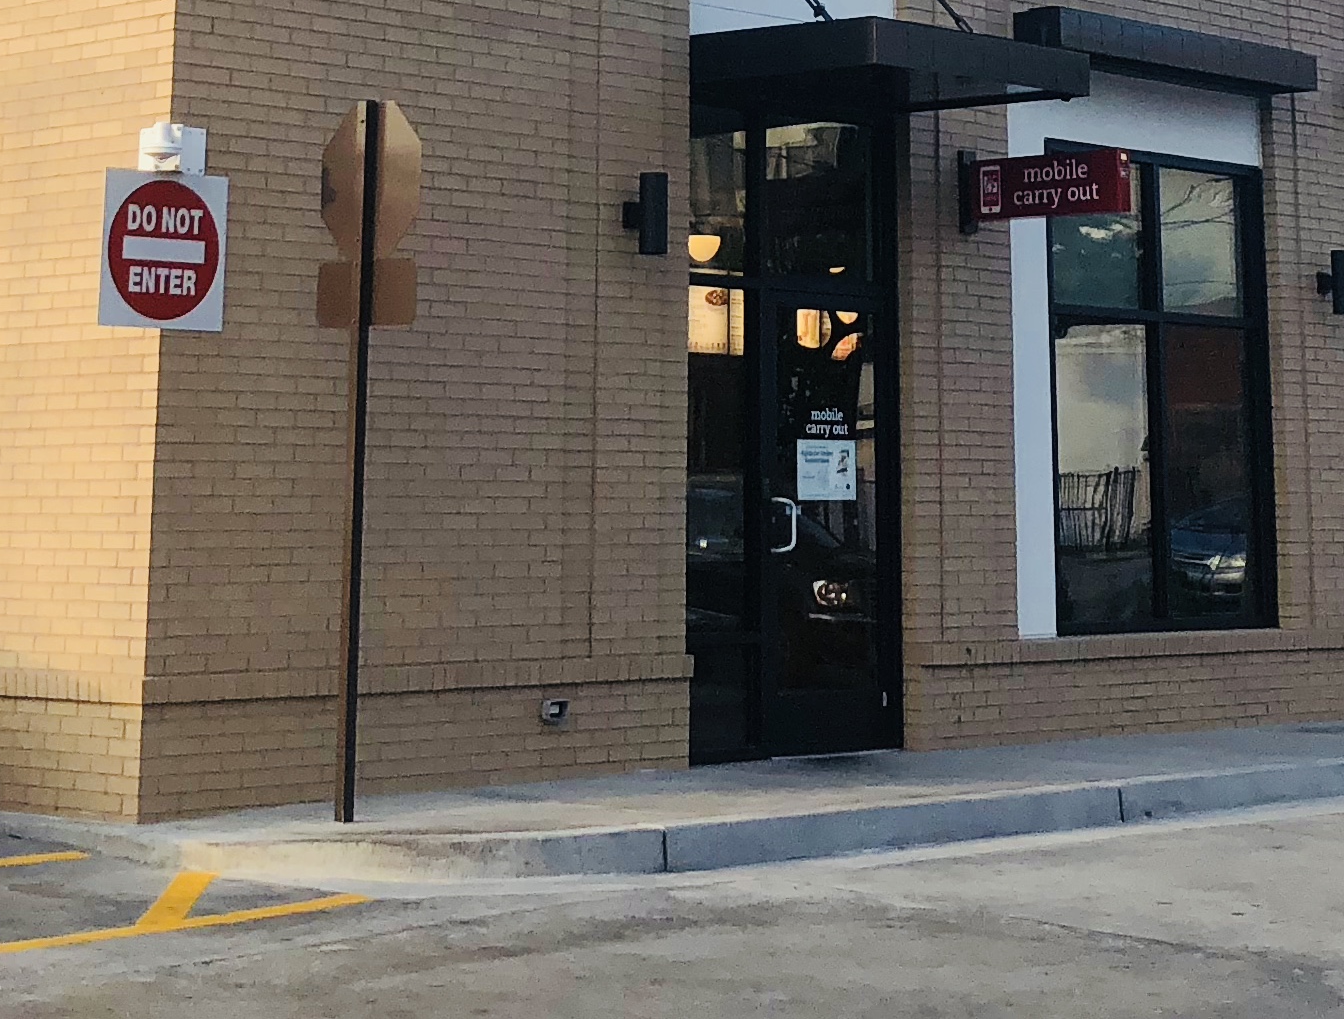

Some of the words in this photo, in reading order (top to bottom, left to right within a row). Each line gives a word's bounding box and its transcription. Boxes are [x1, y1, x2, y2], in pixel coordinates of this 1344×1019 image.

[1023, 158, 1088, 183] mobile
[1013, 187, 1063, 209] carry
[1067, 182, 1100, 202] out
[127, 203, 157, 232] DO
[161, 205, 204, 235] NOT
[128, 265, 197, 296] ENTER
[810, 407, 844, 421] mobile
[805, 423, 831, 438] carry
[832, 423, 849, 435] out
